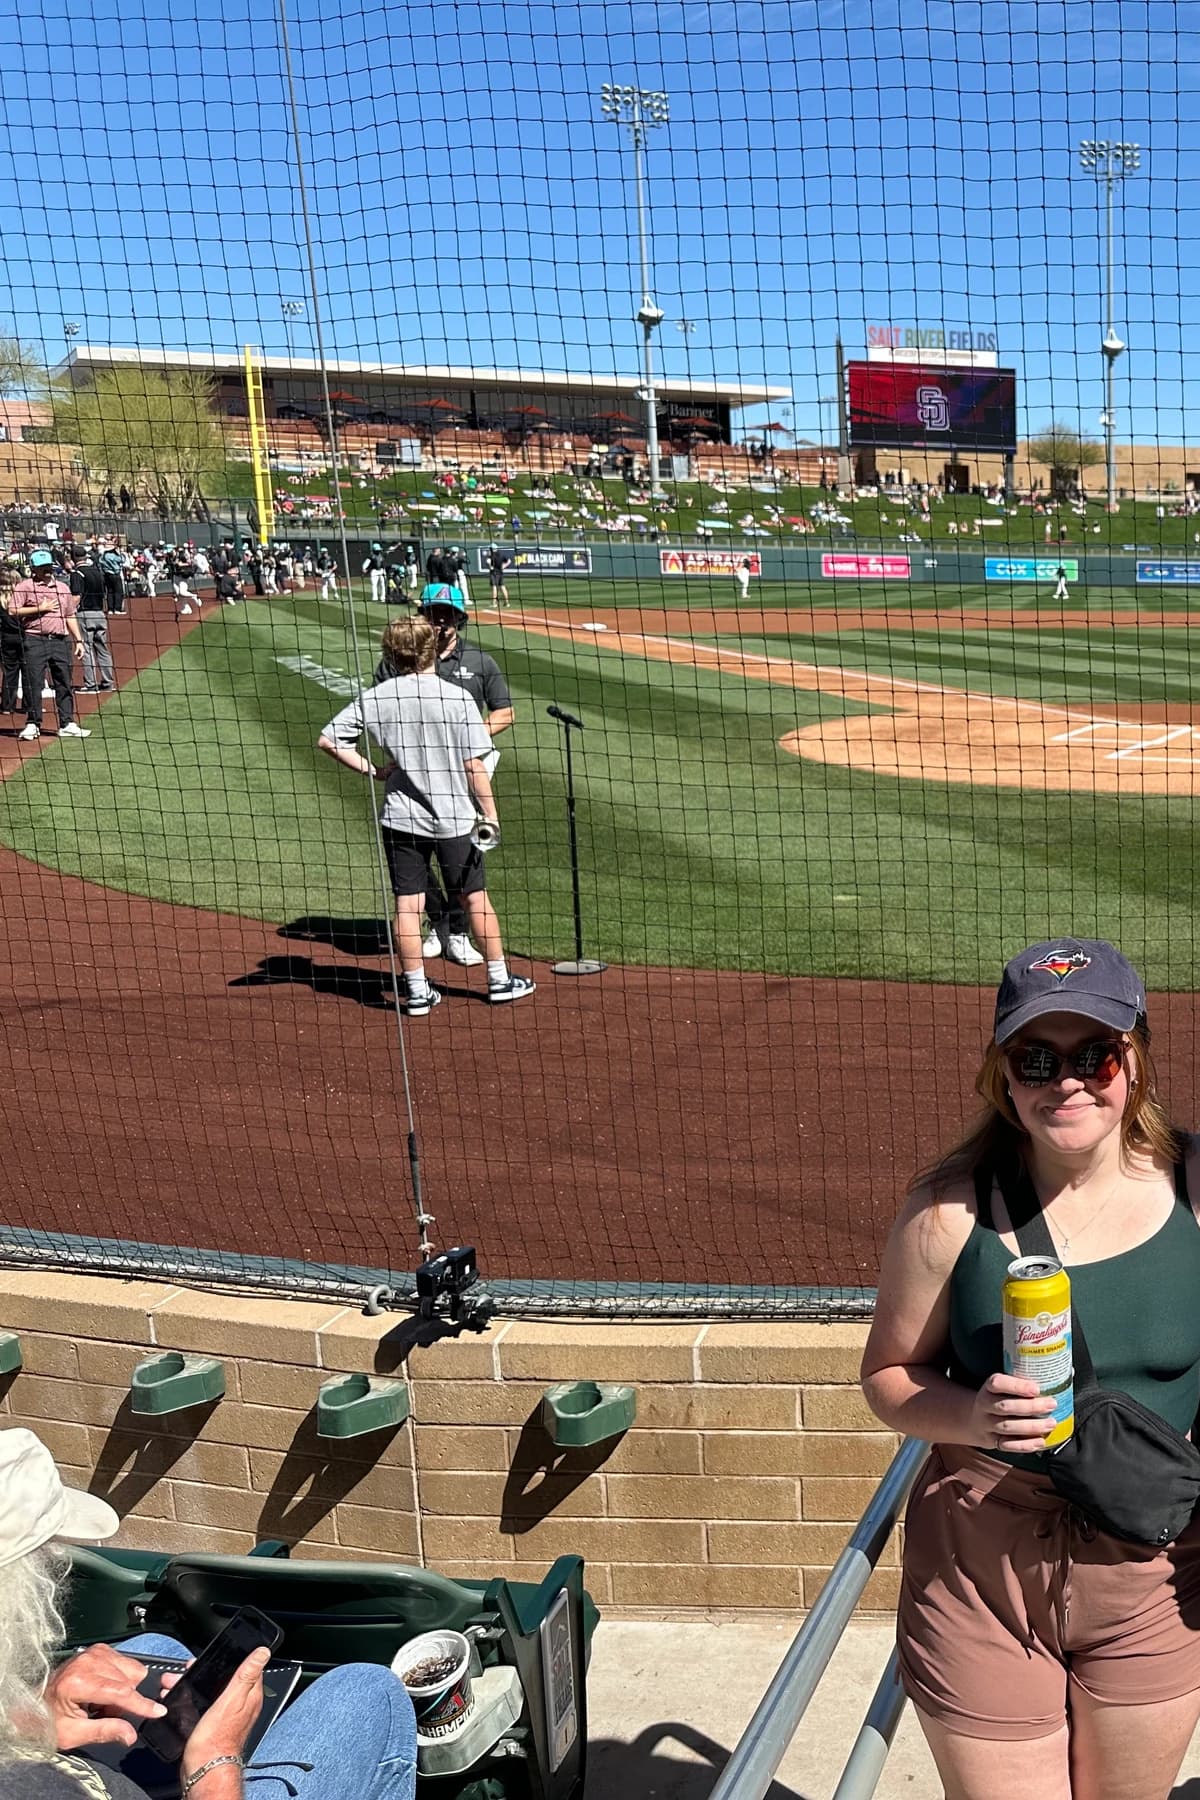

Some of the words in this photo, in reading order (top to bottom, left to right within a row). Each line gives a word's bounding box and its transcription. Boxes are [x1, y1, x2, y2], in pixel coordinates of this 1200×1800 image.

[868, 326, 902, 347] SALT
[905, 328, 944, 350] RIVER
[950, 330, 996, 351] FIELDS
[670, 403, 714, 417] Banner
[995, 563, 1027, 576] COX
